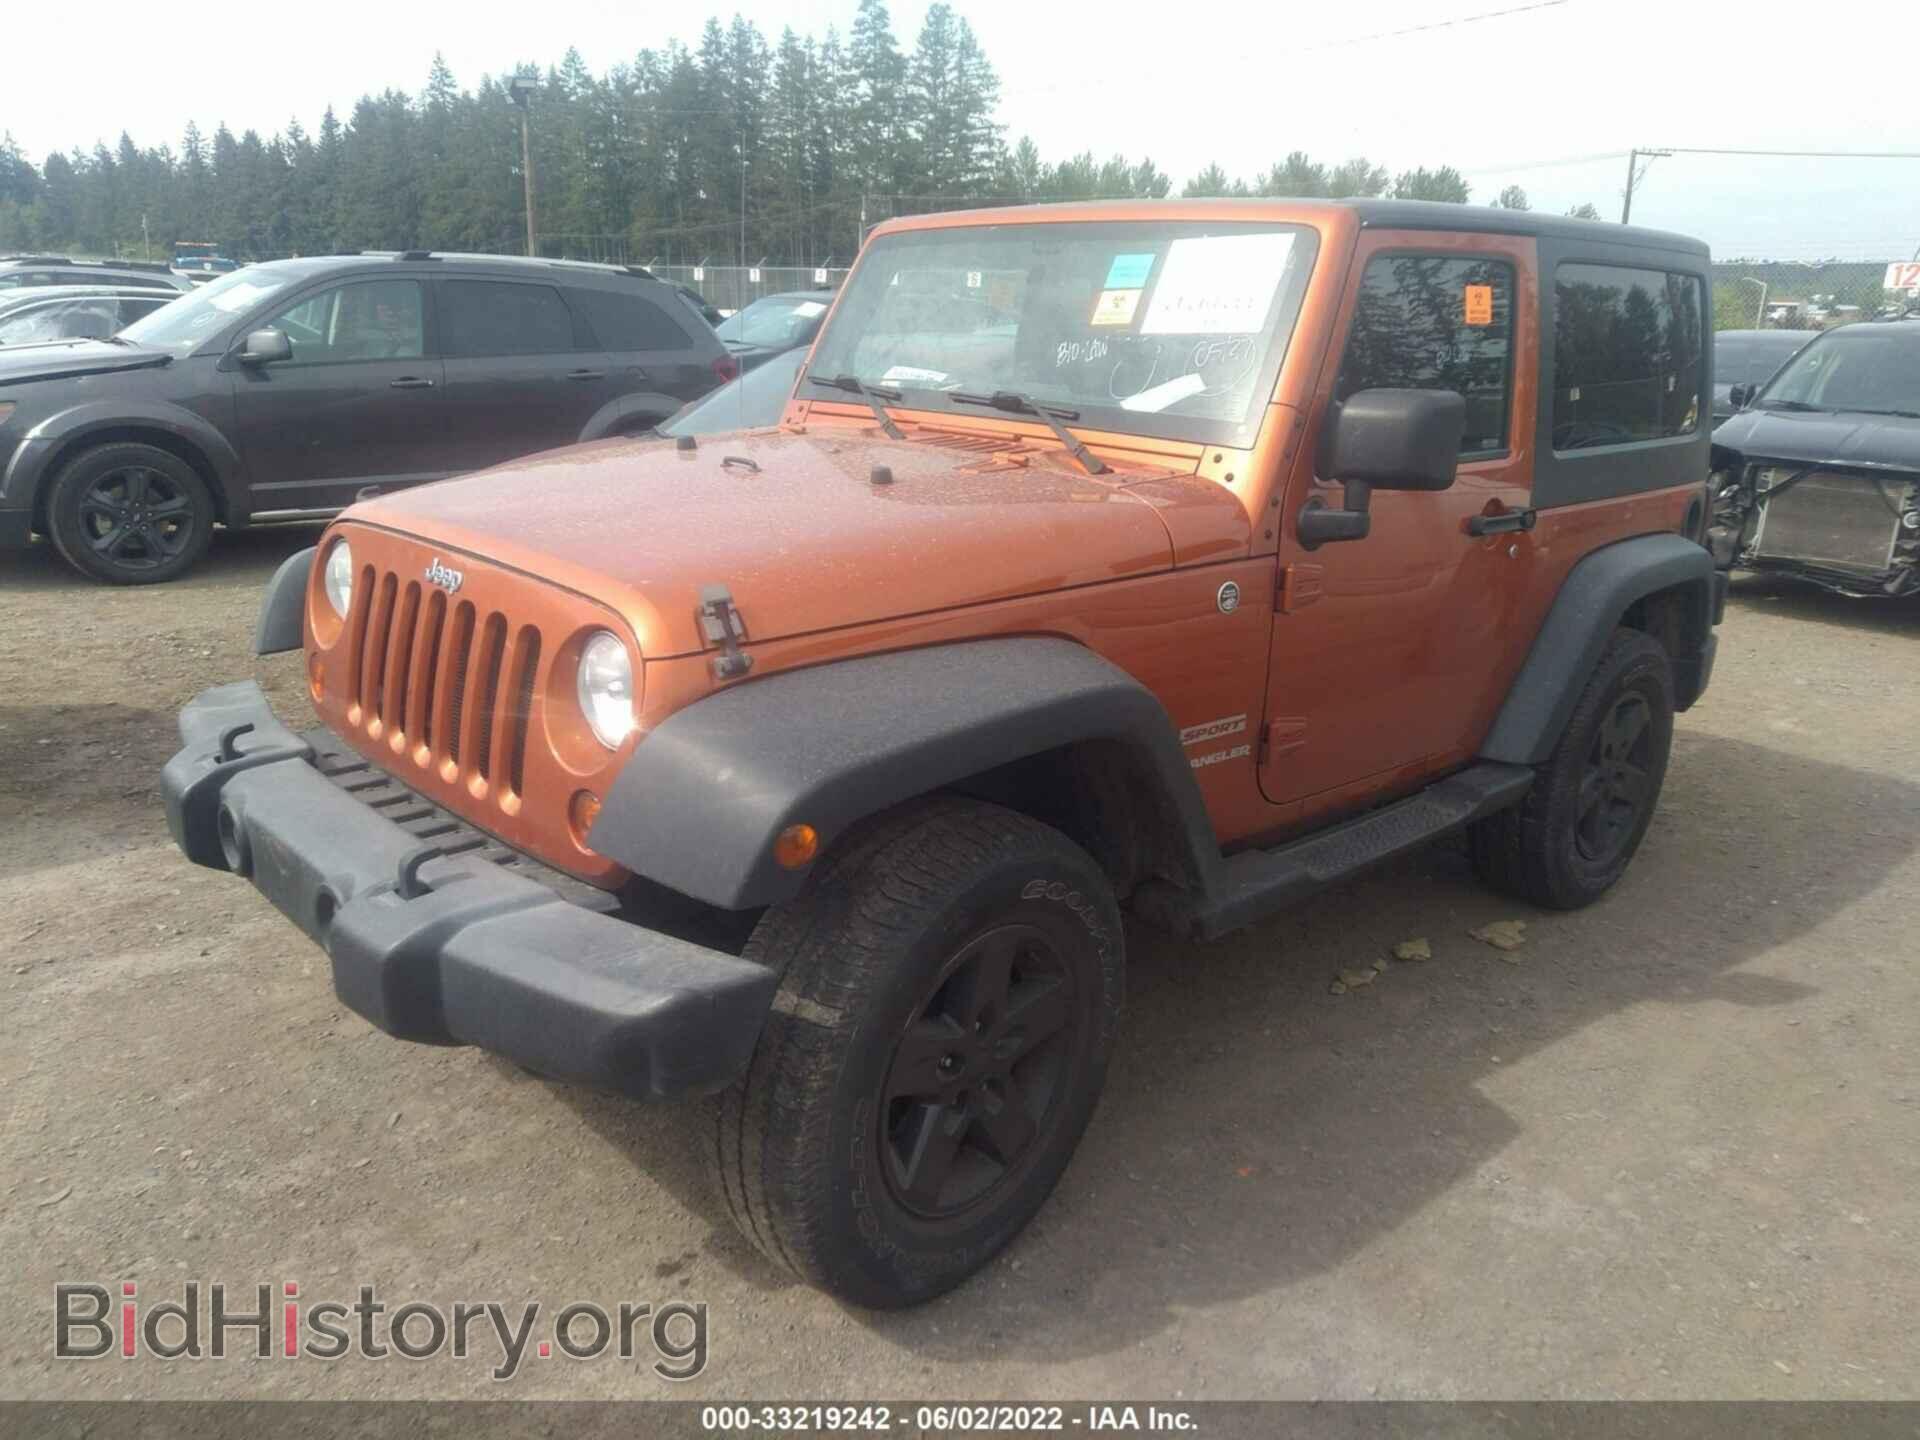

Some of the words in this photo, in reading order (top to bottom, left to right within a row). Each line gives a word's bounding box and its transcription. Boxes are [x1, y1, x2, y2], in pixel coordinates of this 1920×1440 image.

[425, 557, 463, 595] Jeep
[1182, 719, 1244, 742] SPORT
[1190, 745, 1251, 769] ANGLER
